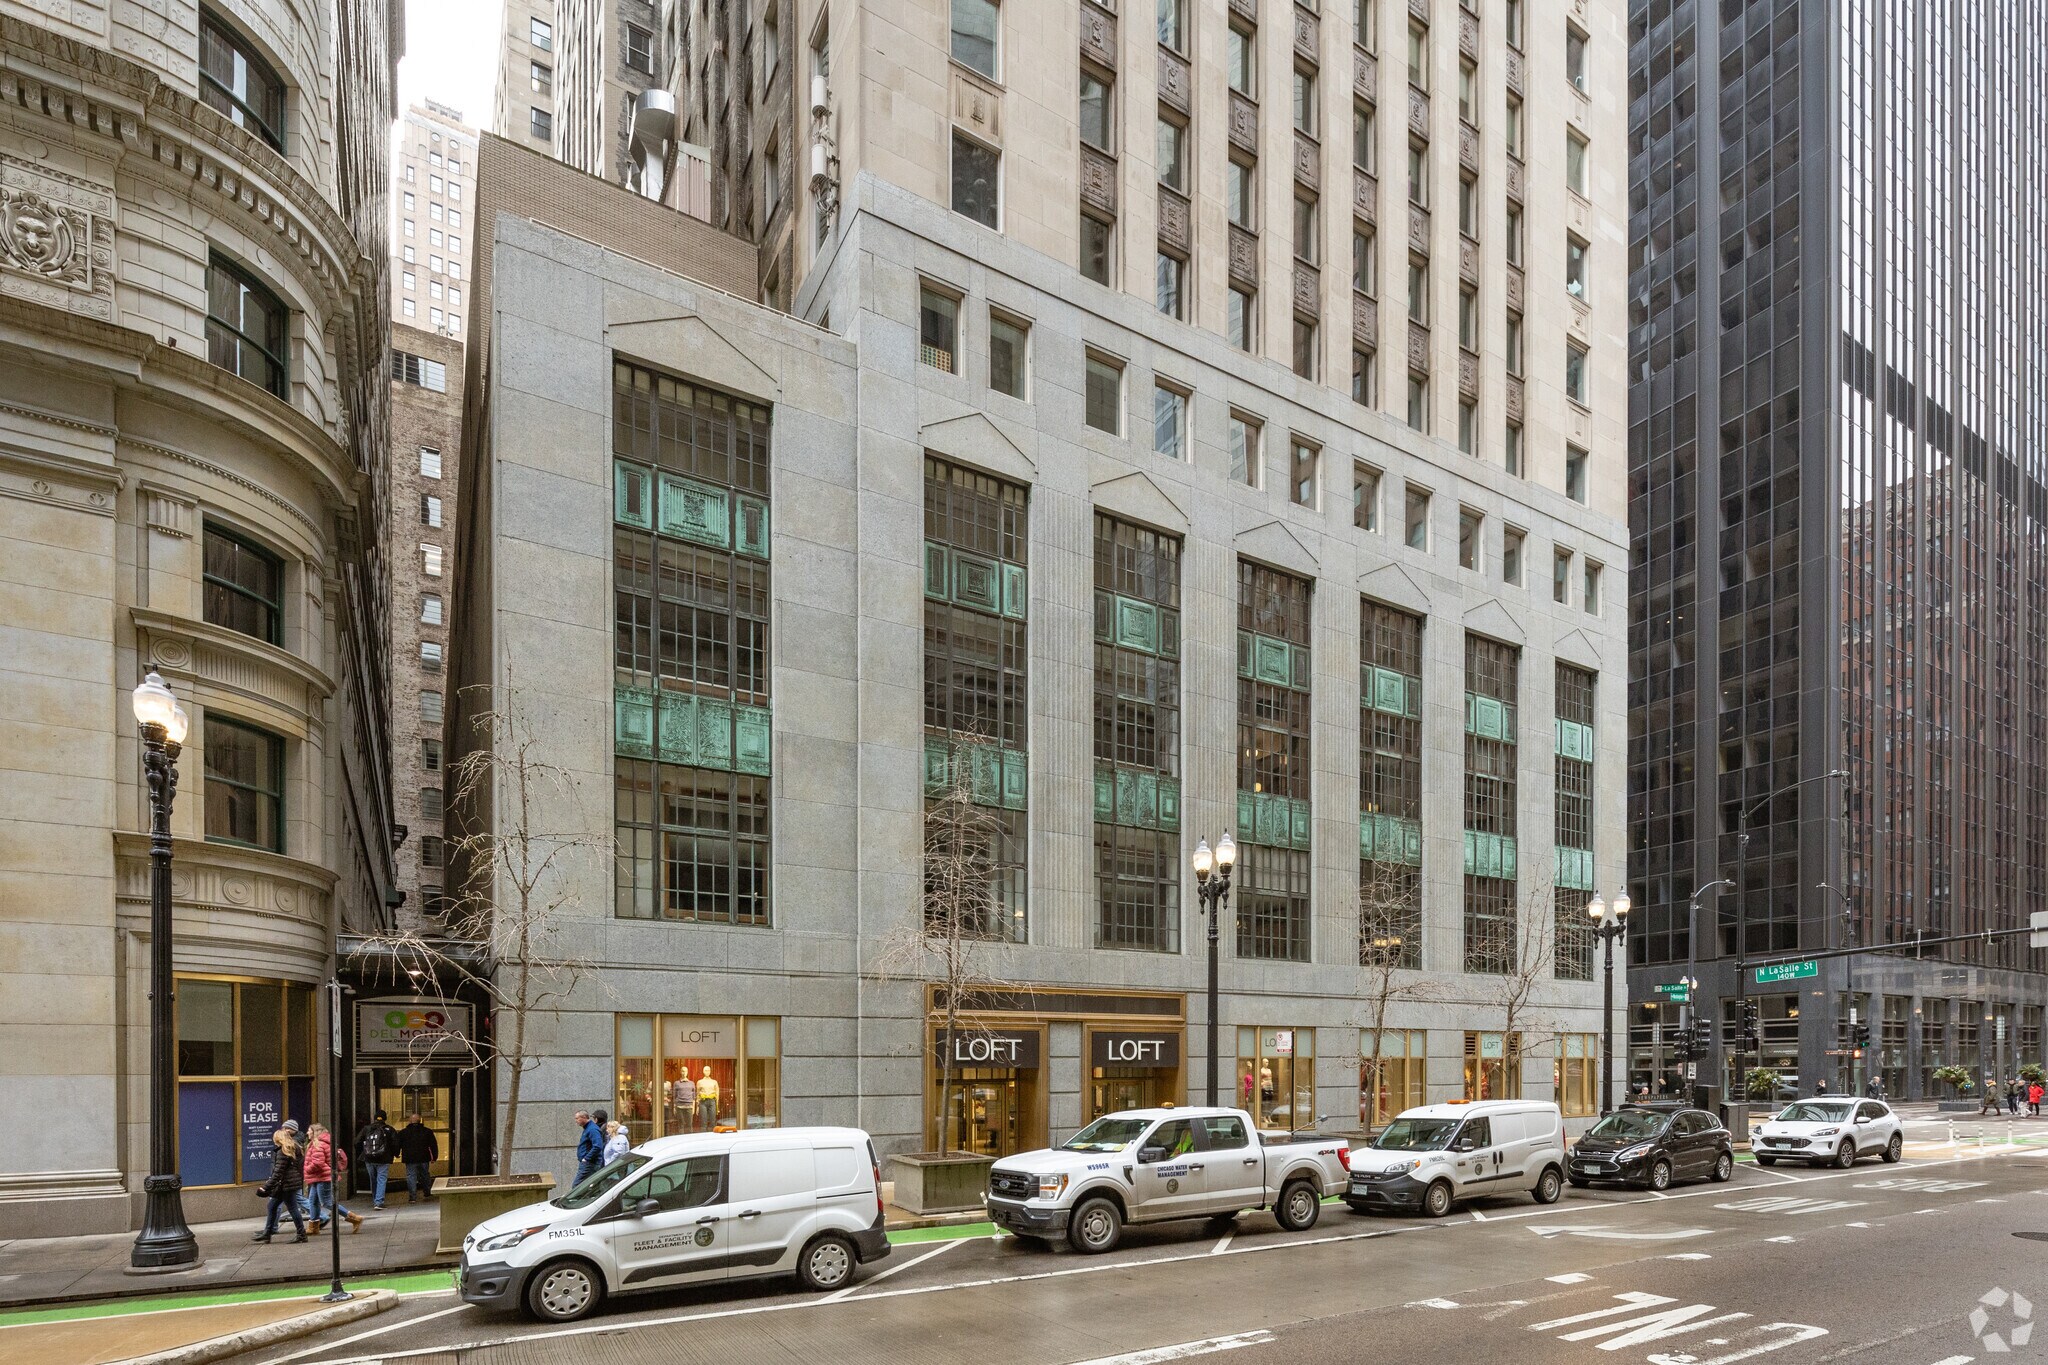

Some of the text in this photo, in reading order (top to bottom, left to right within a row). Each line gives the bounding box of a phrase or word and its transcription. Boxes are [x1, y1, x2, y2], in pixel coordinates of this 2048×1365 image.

[1759, 962, 1813, 976] N LaSalle St
[680, 1030, 721, 1043] LOFT
[955, 1038, 1023, 1061] LOFT
[1108, 1039, 1166, 1061] LOFT
[1483, 1041, 1500, 1050] LOFT
[249, 1102, 273, 1112] FOR
[243, 1112, 278, 1123] LEASE
[1157, 1170, 1188, 1178] MANAGEMENT
[548, 1228, 585, 1240] FM351L
[634, 1239, 655, 1247] FLEET
[664, 1234, 693, 1243] FACILITY
[634, 1240, 693, 1251] MANAGEMENT
